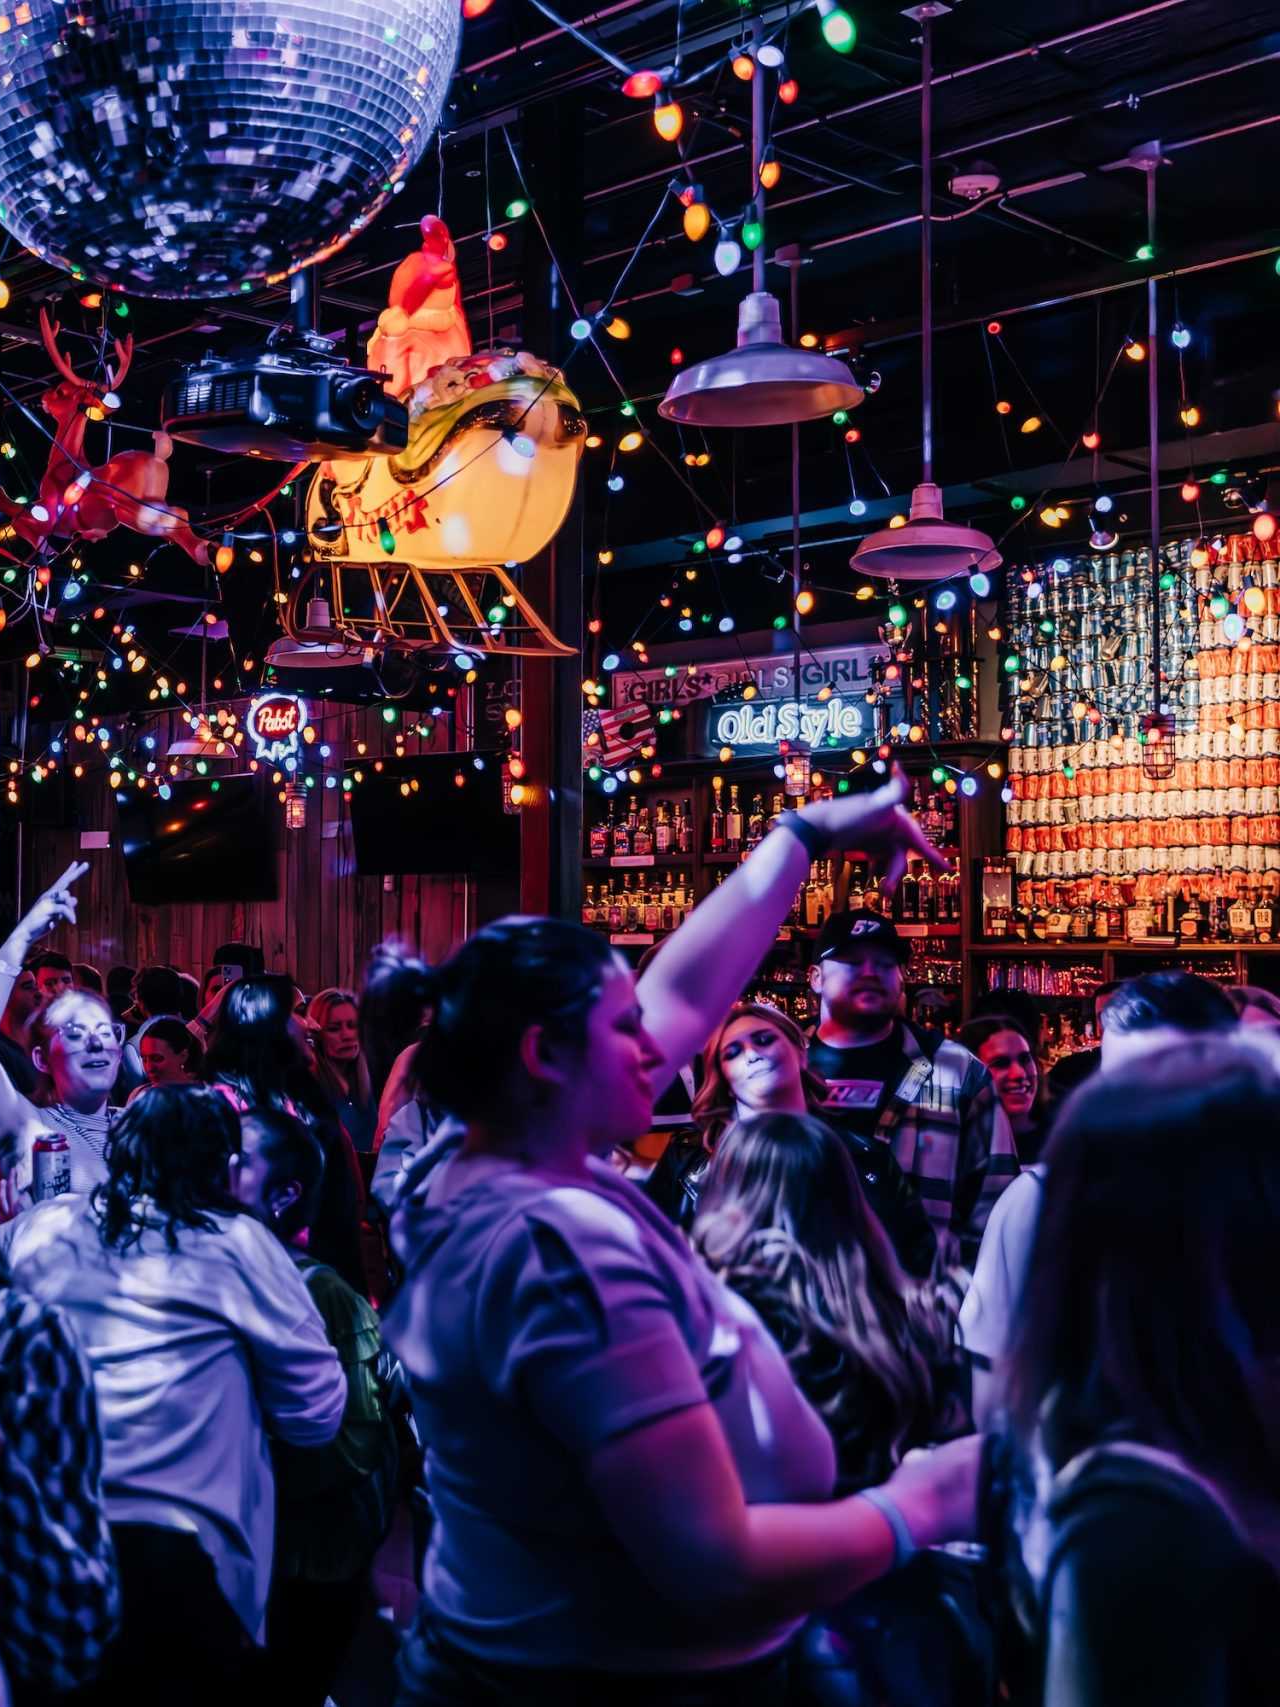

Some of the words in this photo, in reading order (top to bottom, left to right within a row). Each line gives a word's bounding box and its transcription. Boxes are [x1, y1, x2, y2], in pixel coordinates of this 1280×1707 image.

[629, 676, 702, 703] GIRLS
[801, 658, 872, 685] GIRL
[258, 705, 296, 733] Pabst
[718, 704, 776, 744] Old
[850, 919, 881, 935] 57
